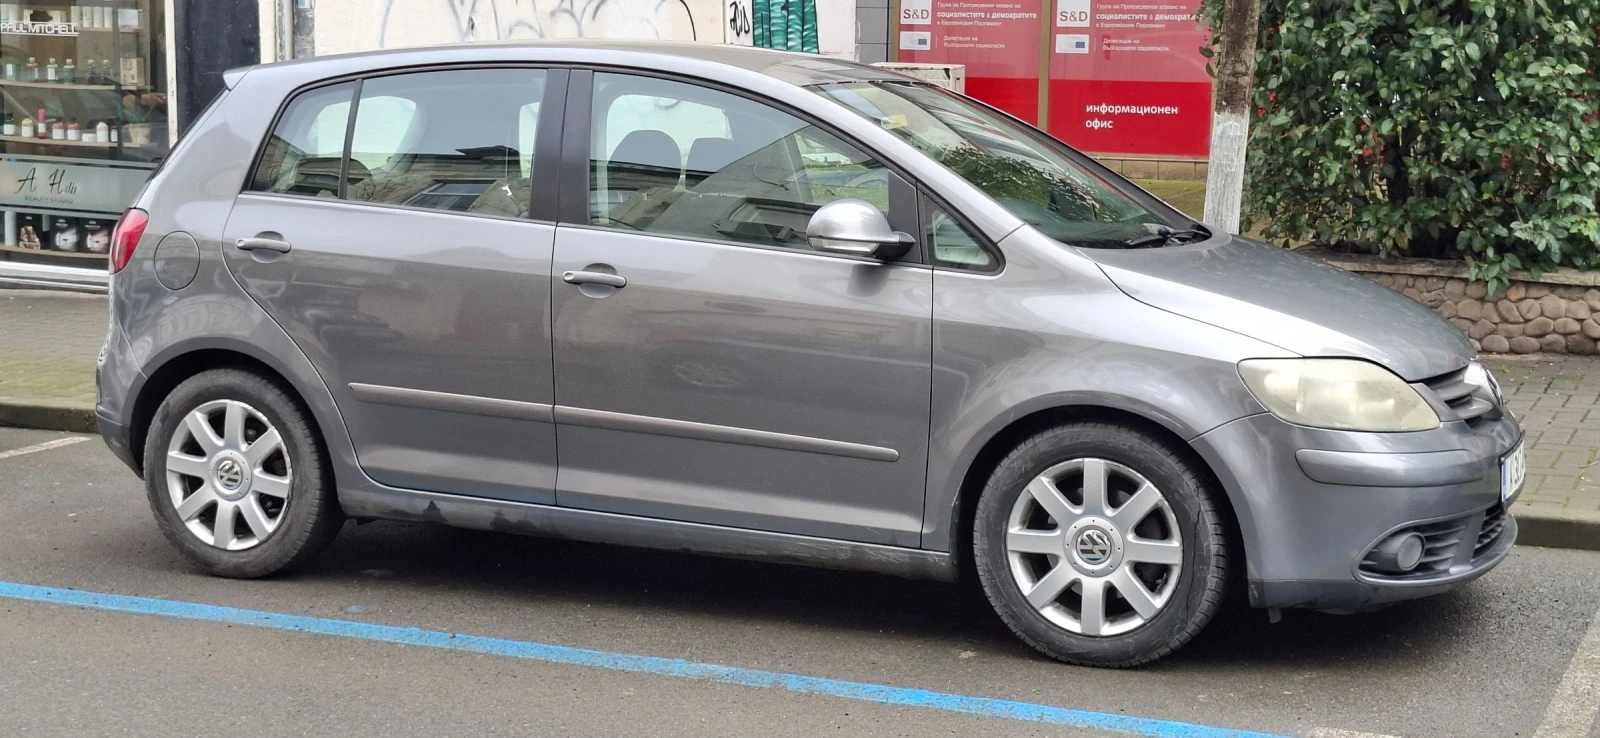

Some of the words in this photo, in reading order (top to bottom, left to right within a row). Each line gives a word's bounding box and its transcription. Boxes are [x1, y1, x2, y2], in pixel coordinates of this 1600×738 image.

[903, 8, 930, 20] S&D
[991, 12, 1037, 20] демократите
[1059, 10, 1088, 22] S&D
[0, 22, 27, 33] PAUL
[28, 24, 78, 35] MITCHELL
[1086, 102, 1178, 116] информационен
[1085, 117, 1114, 130] офис
